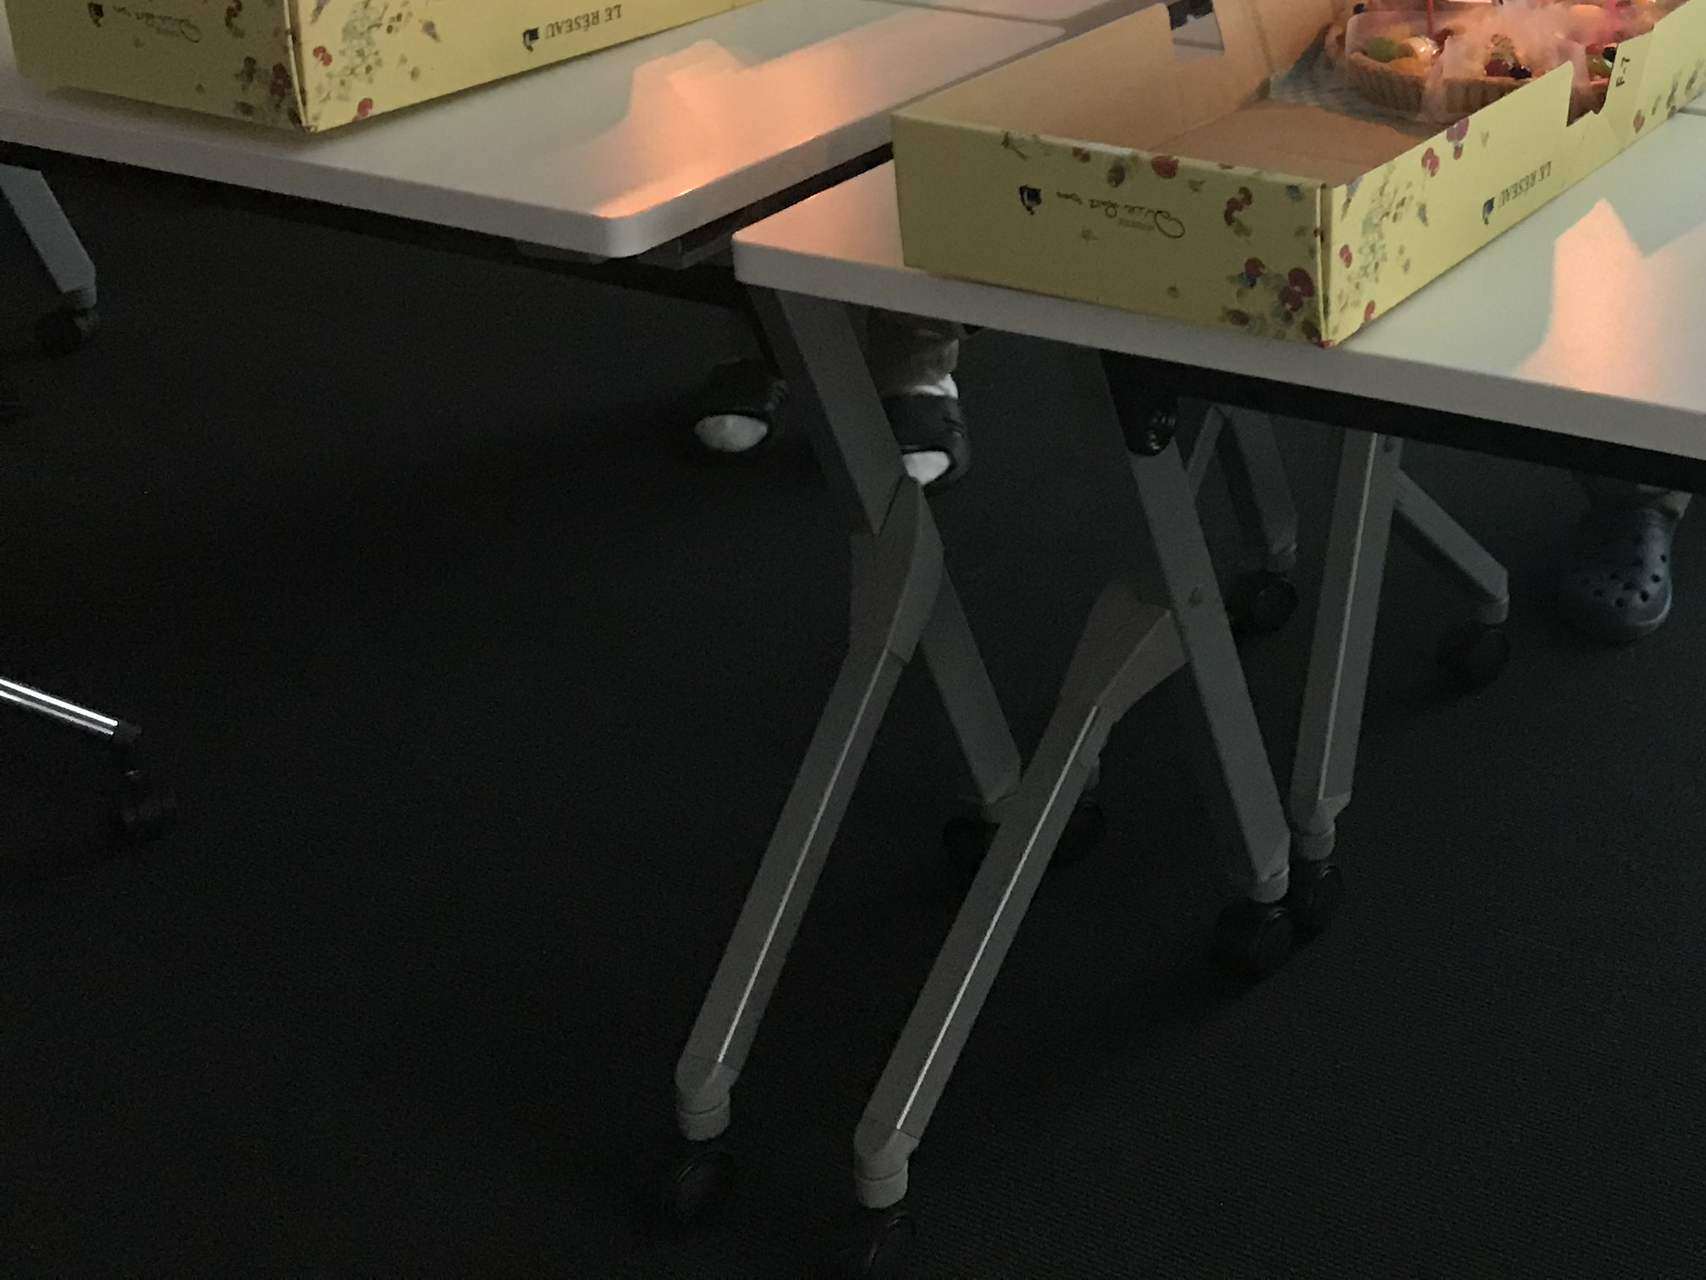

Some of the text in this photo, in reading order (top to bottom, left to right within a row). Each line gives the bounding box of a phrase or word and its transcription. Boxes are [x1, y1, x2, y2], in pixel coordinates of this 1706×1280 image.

[544, 4, 622, 39] LE RÉSEAU
[1615, 56, 1631, 87] F-7
[1498, 161, 1552, 209] LE RÉSEAU
